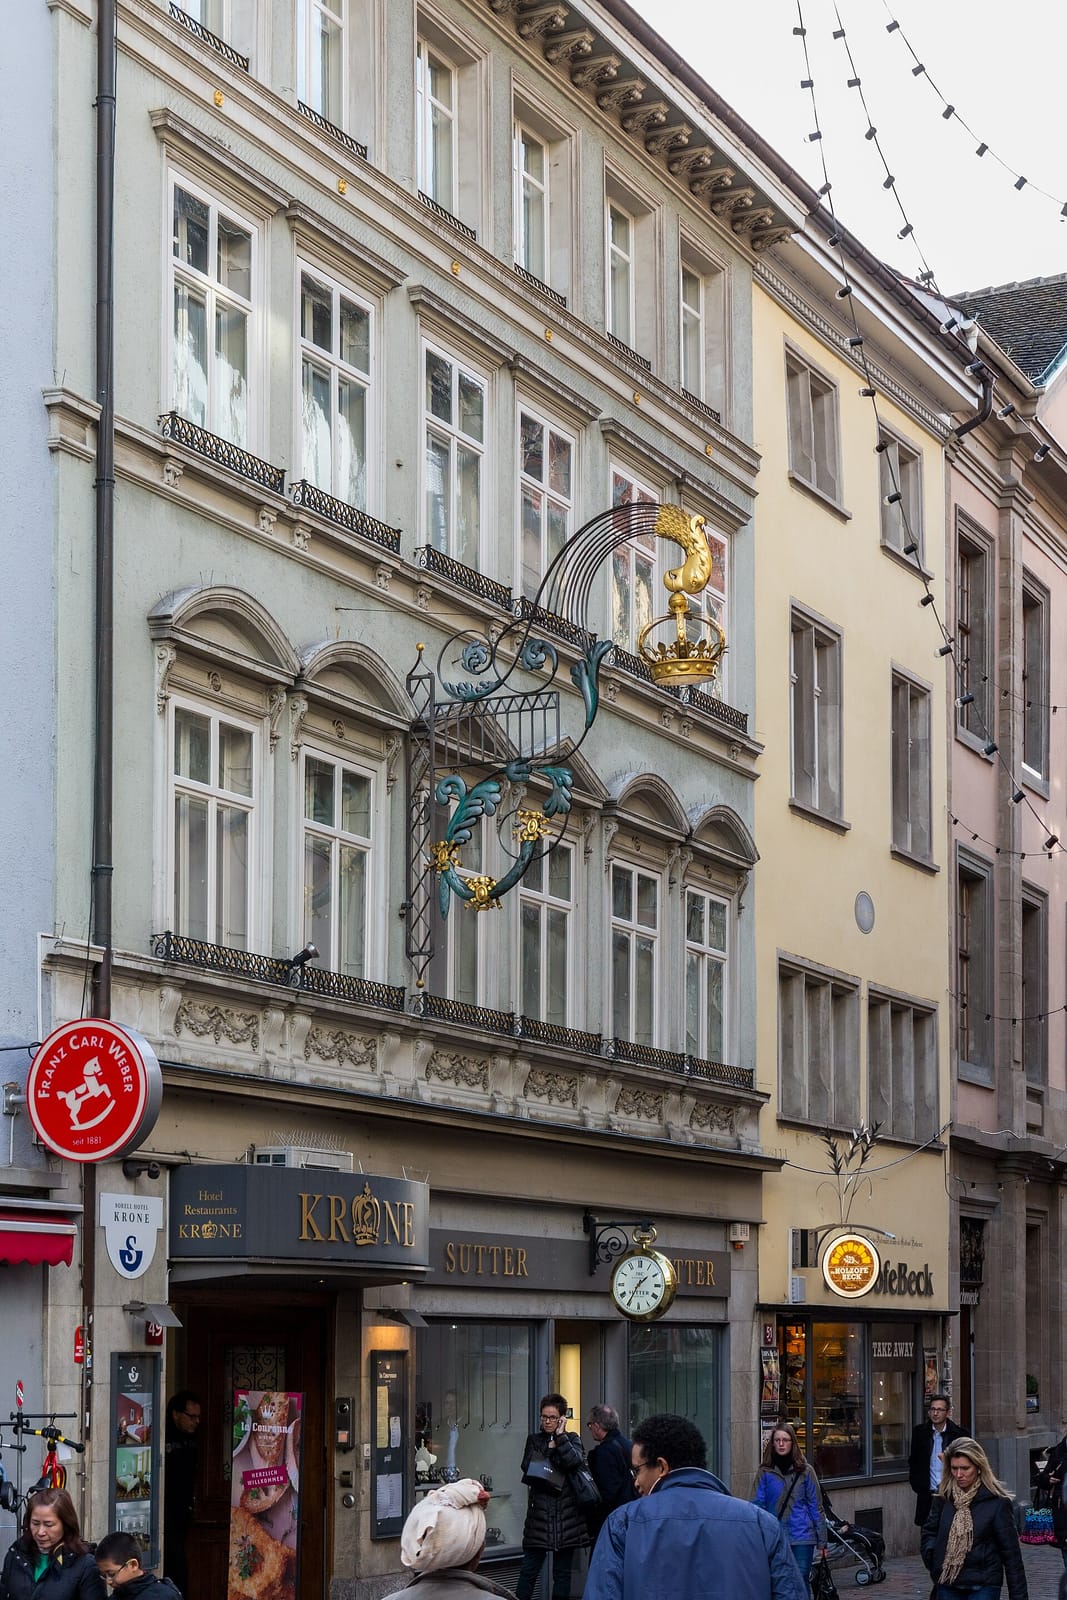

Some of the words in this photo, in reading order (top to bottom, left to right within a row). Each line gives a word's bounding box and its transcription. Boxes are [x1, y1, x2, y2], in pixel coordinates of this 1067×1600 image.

[38, 1047, 67, 1098] FRANZ
[69, 1035, 104, 1050] CARL
[108, 1040, 133, 1093] WEBER
[72, 1138, 84, 1146] seit
[86, 1136, 102, 1145] 1881
[199, 1190, 223, 1201] Hotel
[184, 1204, 238, 1216] Restaurants
[114, 1211, 150, 1224] KRONE
[446, 1242, 528, 1276] SUTTER
[673, 1258, 716, 1286] TTER
[873, 1260, 934, 1297] ofeBeck
[872, 1342, 893, 1357] TAKE
[893, 1342, 914, 1357] AWAY
[252, 1423, 293, 1434] Couronne
[251, 1469, 278, 1478] HERZLICH
[247, 1476, 284, 1486] WILLKOMMEN
